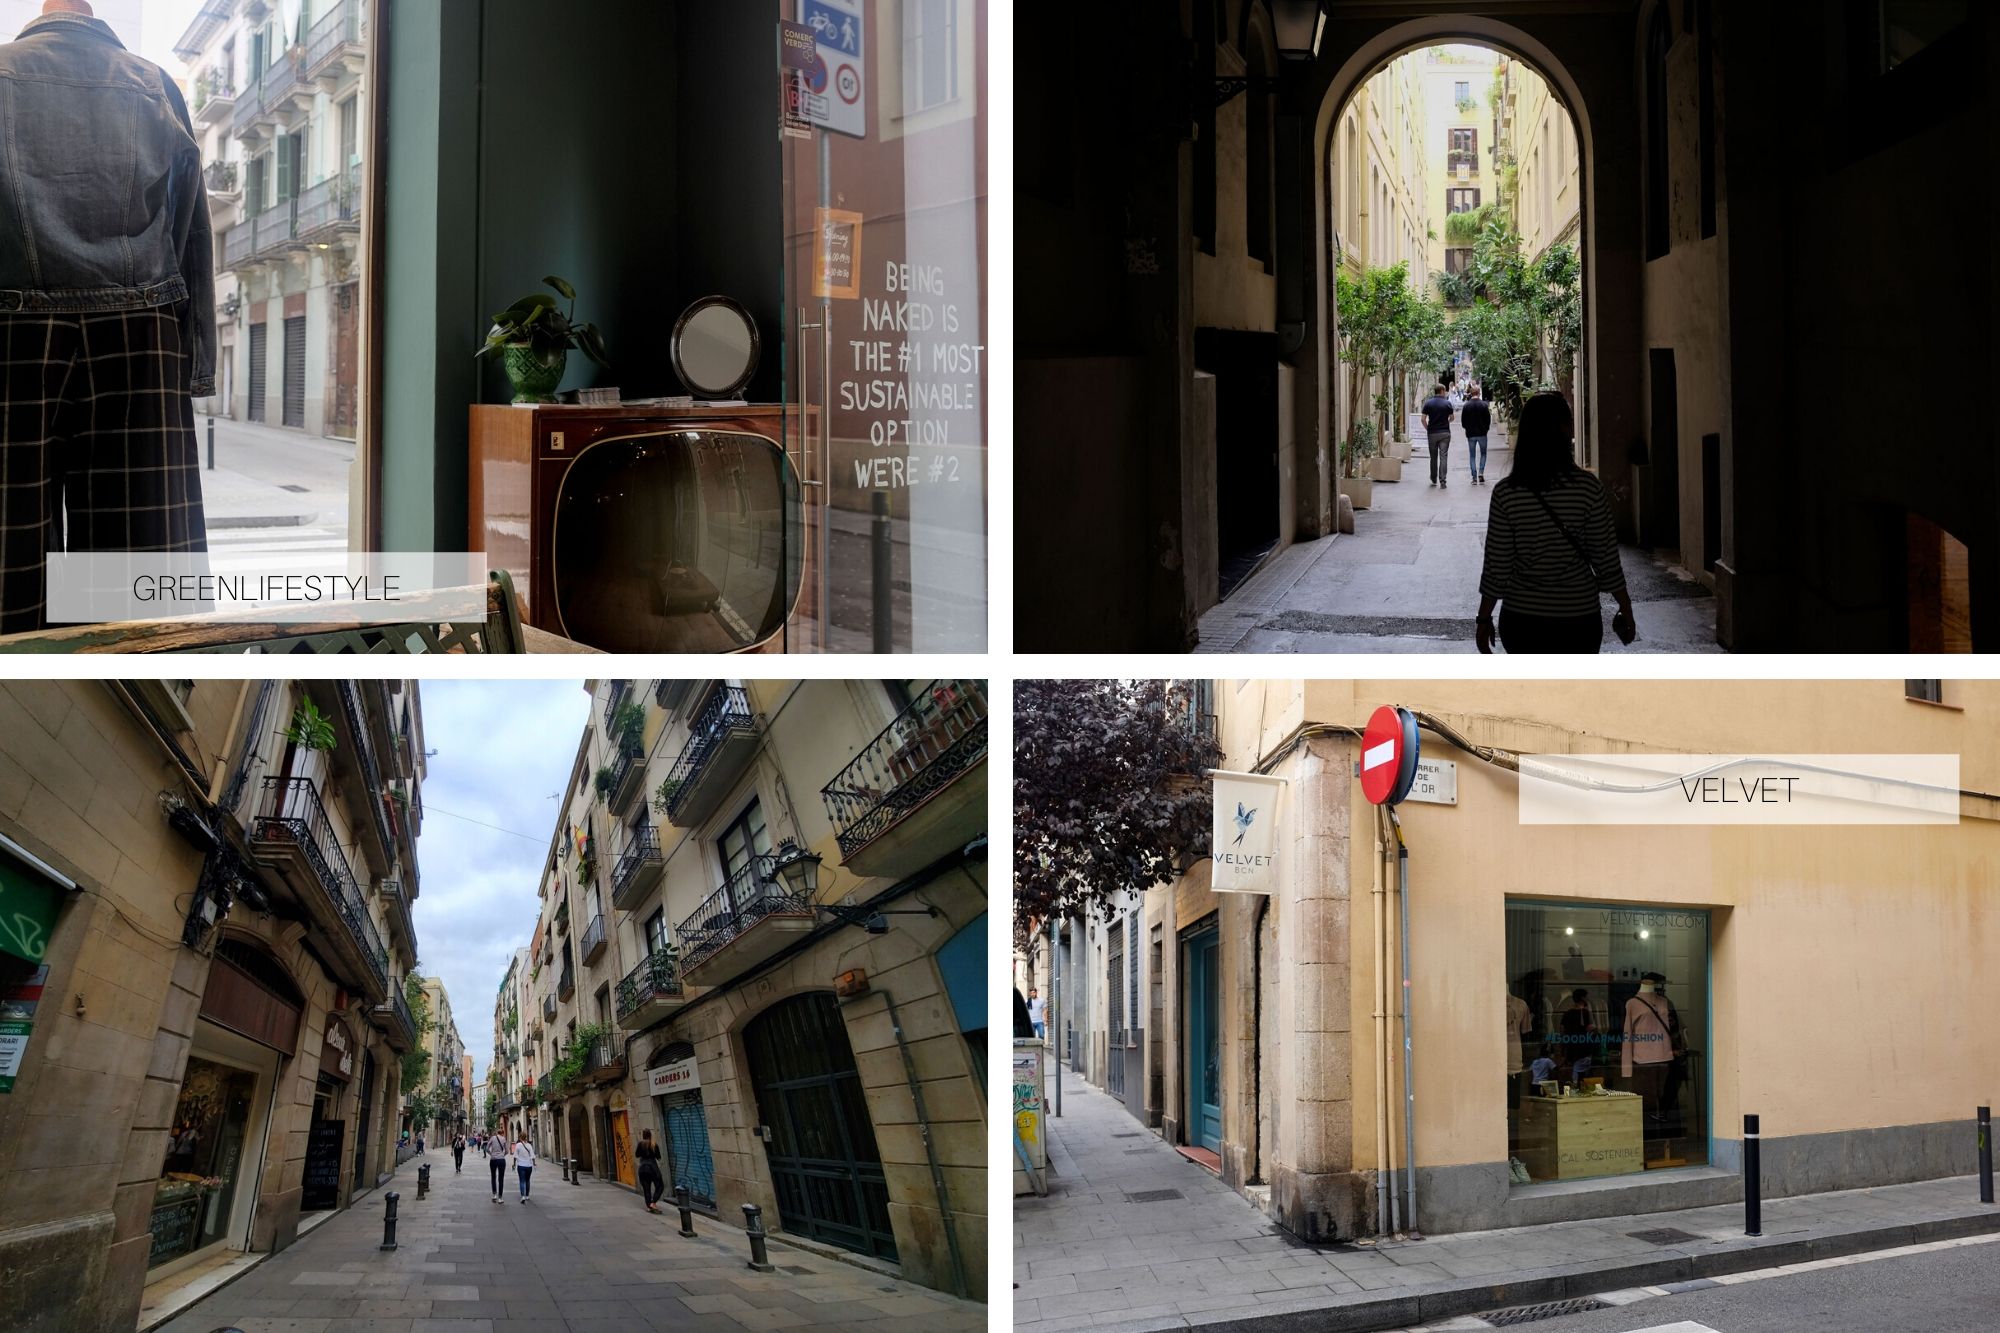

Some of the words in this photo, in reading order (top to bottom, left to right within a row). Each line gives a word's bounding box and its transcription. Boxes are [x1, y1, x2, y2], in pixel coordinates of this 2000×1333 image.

[784, 37, 803, 49] VERD
[886, 260, 944, 296] BEING
[863, 297, 934, 332] NAKED
[942, 303, 960, 333] IS
[850, 340, 892, 372] THE
[898, 341, 921, 373] #1
[933, 342, 984, 375] MOST
[840, 379, 974, 412] SUSTAINABLE
[870, 419, 949, 447] OPTION
[854, 456, 920, 489] WE'RE
[928, 455, 960, 483] #2
[1417, 764, 1440, 774] RRER
[1417, 773, 1429, 781] DE
[1214, 852, 1272, 867] VELVET
[1234, 866, 1254, 875] BCN
[1600, 911, 1705, 929] VELVETBCN.COM
[654, 1071, 680, 1086] CARDERS
[1584, 1146, 1641, 1162] SOSTENIBLE
